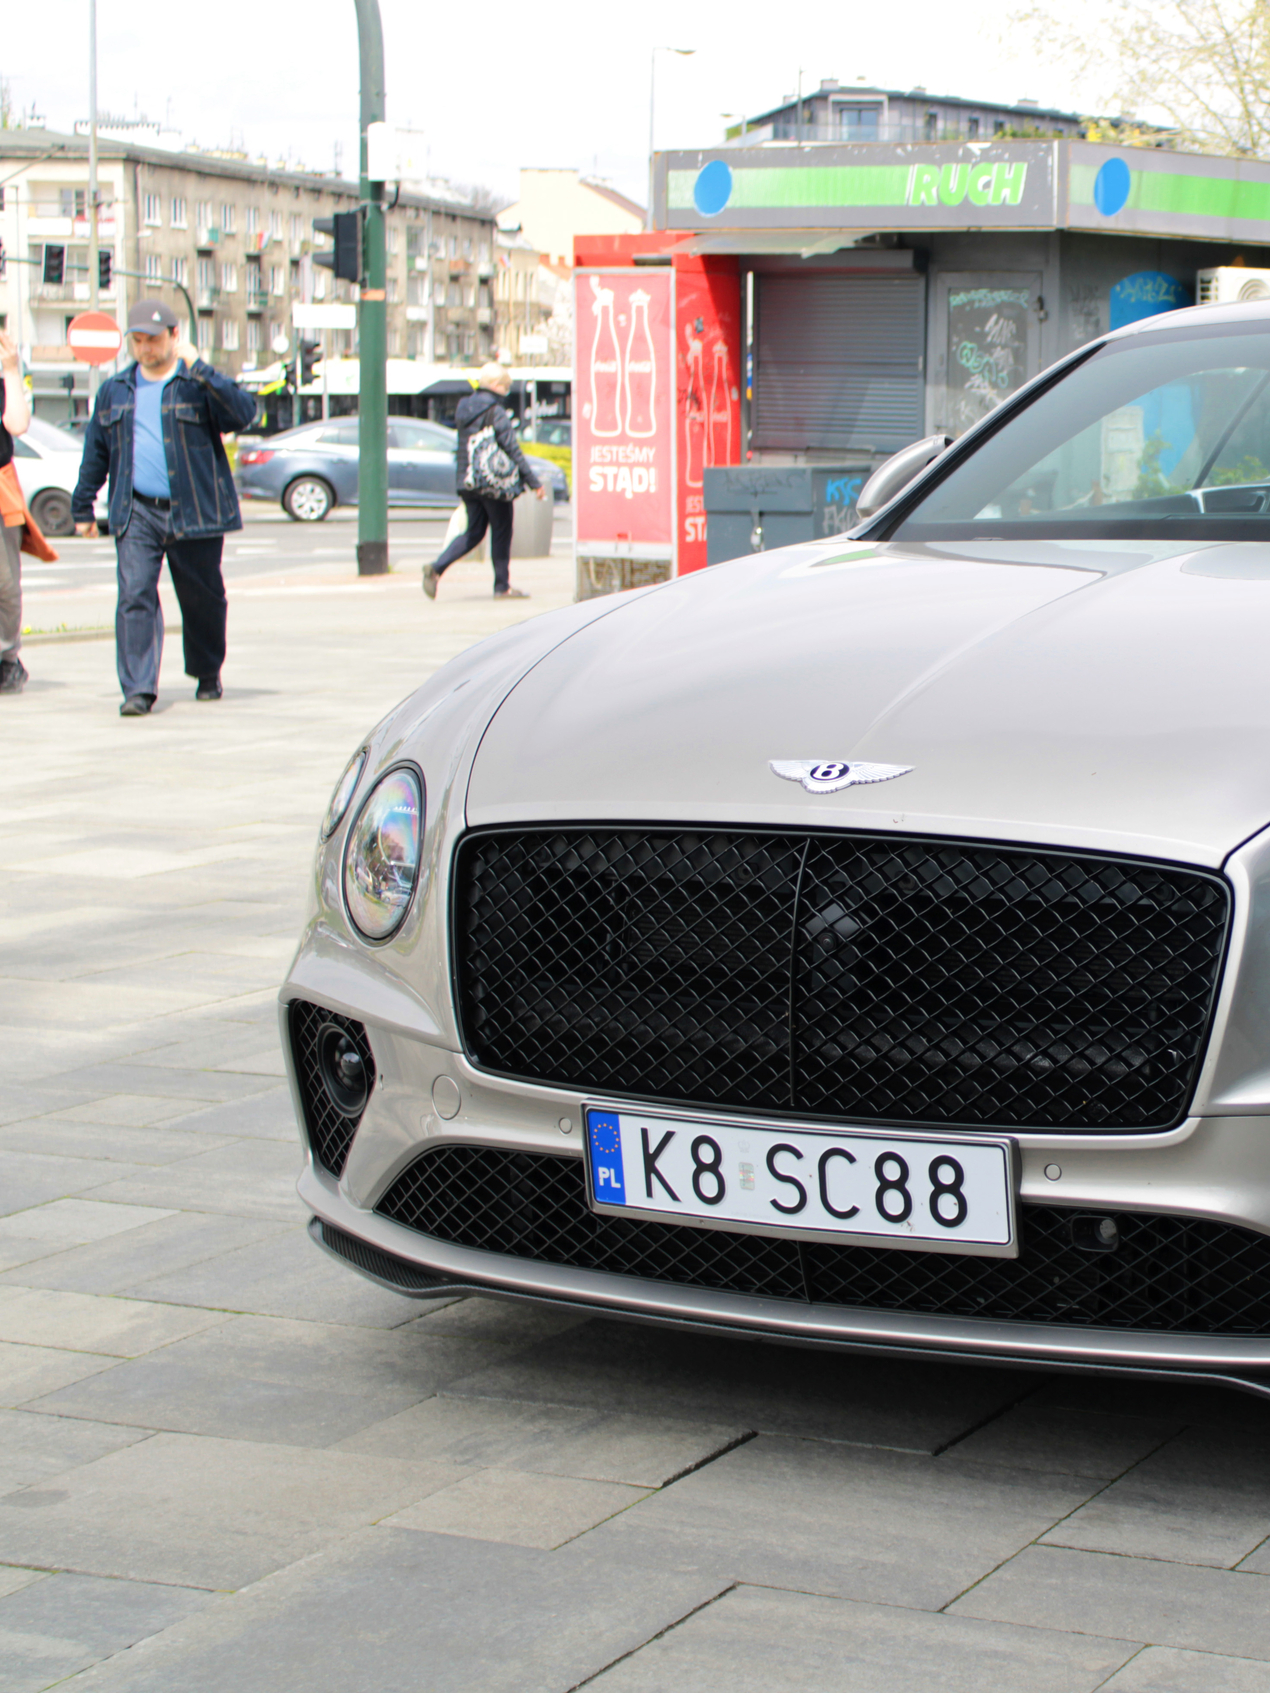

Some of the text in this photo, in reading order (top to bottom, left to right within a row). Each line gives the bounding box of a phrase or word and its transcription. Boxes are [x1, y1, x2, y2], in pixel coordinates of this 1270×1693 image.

[909, 161, 1028, 207] RUCH
[590, 443, 656, 464] JESTEŚMY
[589, 466, 657, 499] STĄD!
[598, 1166, 621, 1189] PL
[640, 1127, 968, 1228] K8 SC88
